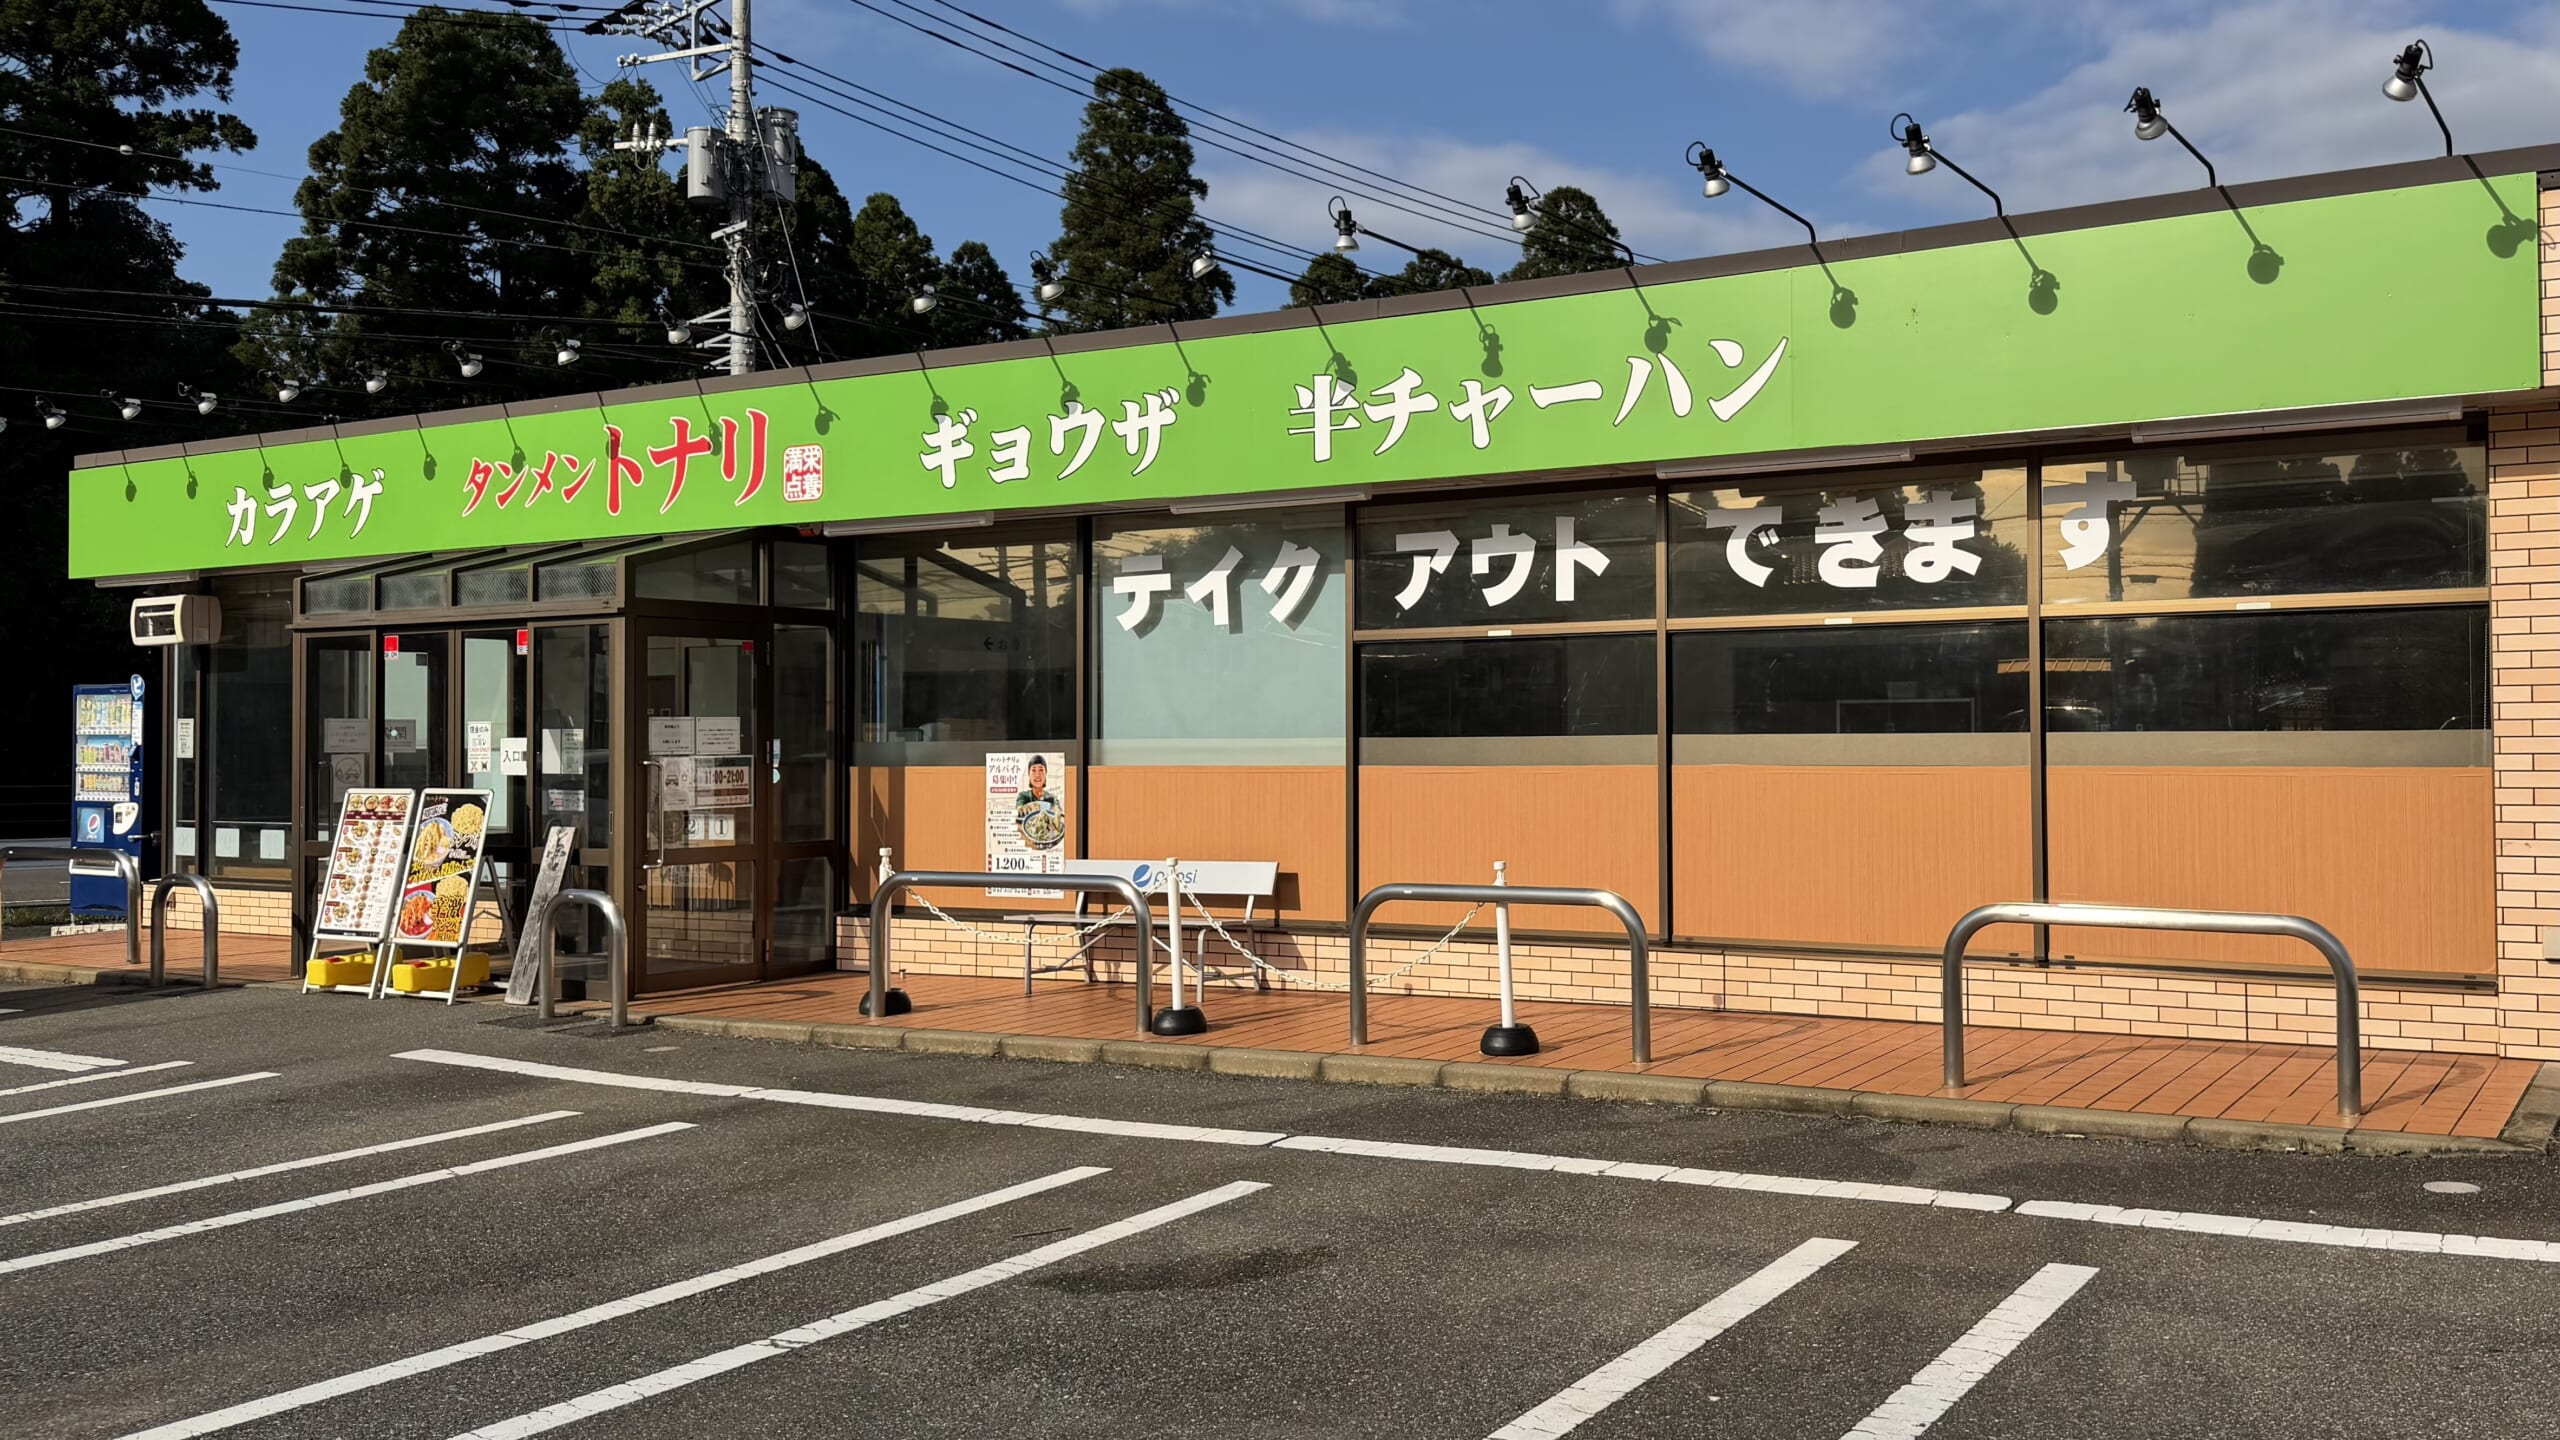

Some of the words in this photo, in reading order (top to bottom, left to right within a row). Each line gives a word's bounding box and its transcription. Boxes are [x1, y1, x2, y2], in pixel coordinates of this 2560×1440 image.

[224, 466, 387, 548] カラアゲ
[918, 384, 1180, 490] ギョウザ
[1286, 335, 1792, 463] 半チャーハン
[1394, 514, 1612, 612] アウト
[502, 750, 521, 763] 入口
[989, 764, 1022, 774] アルバイト
